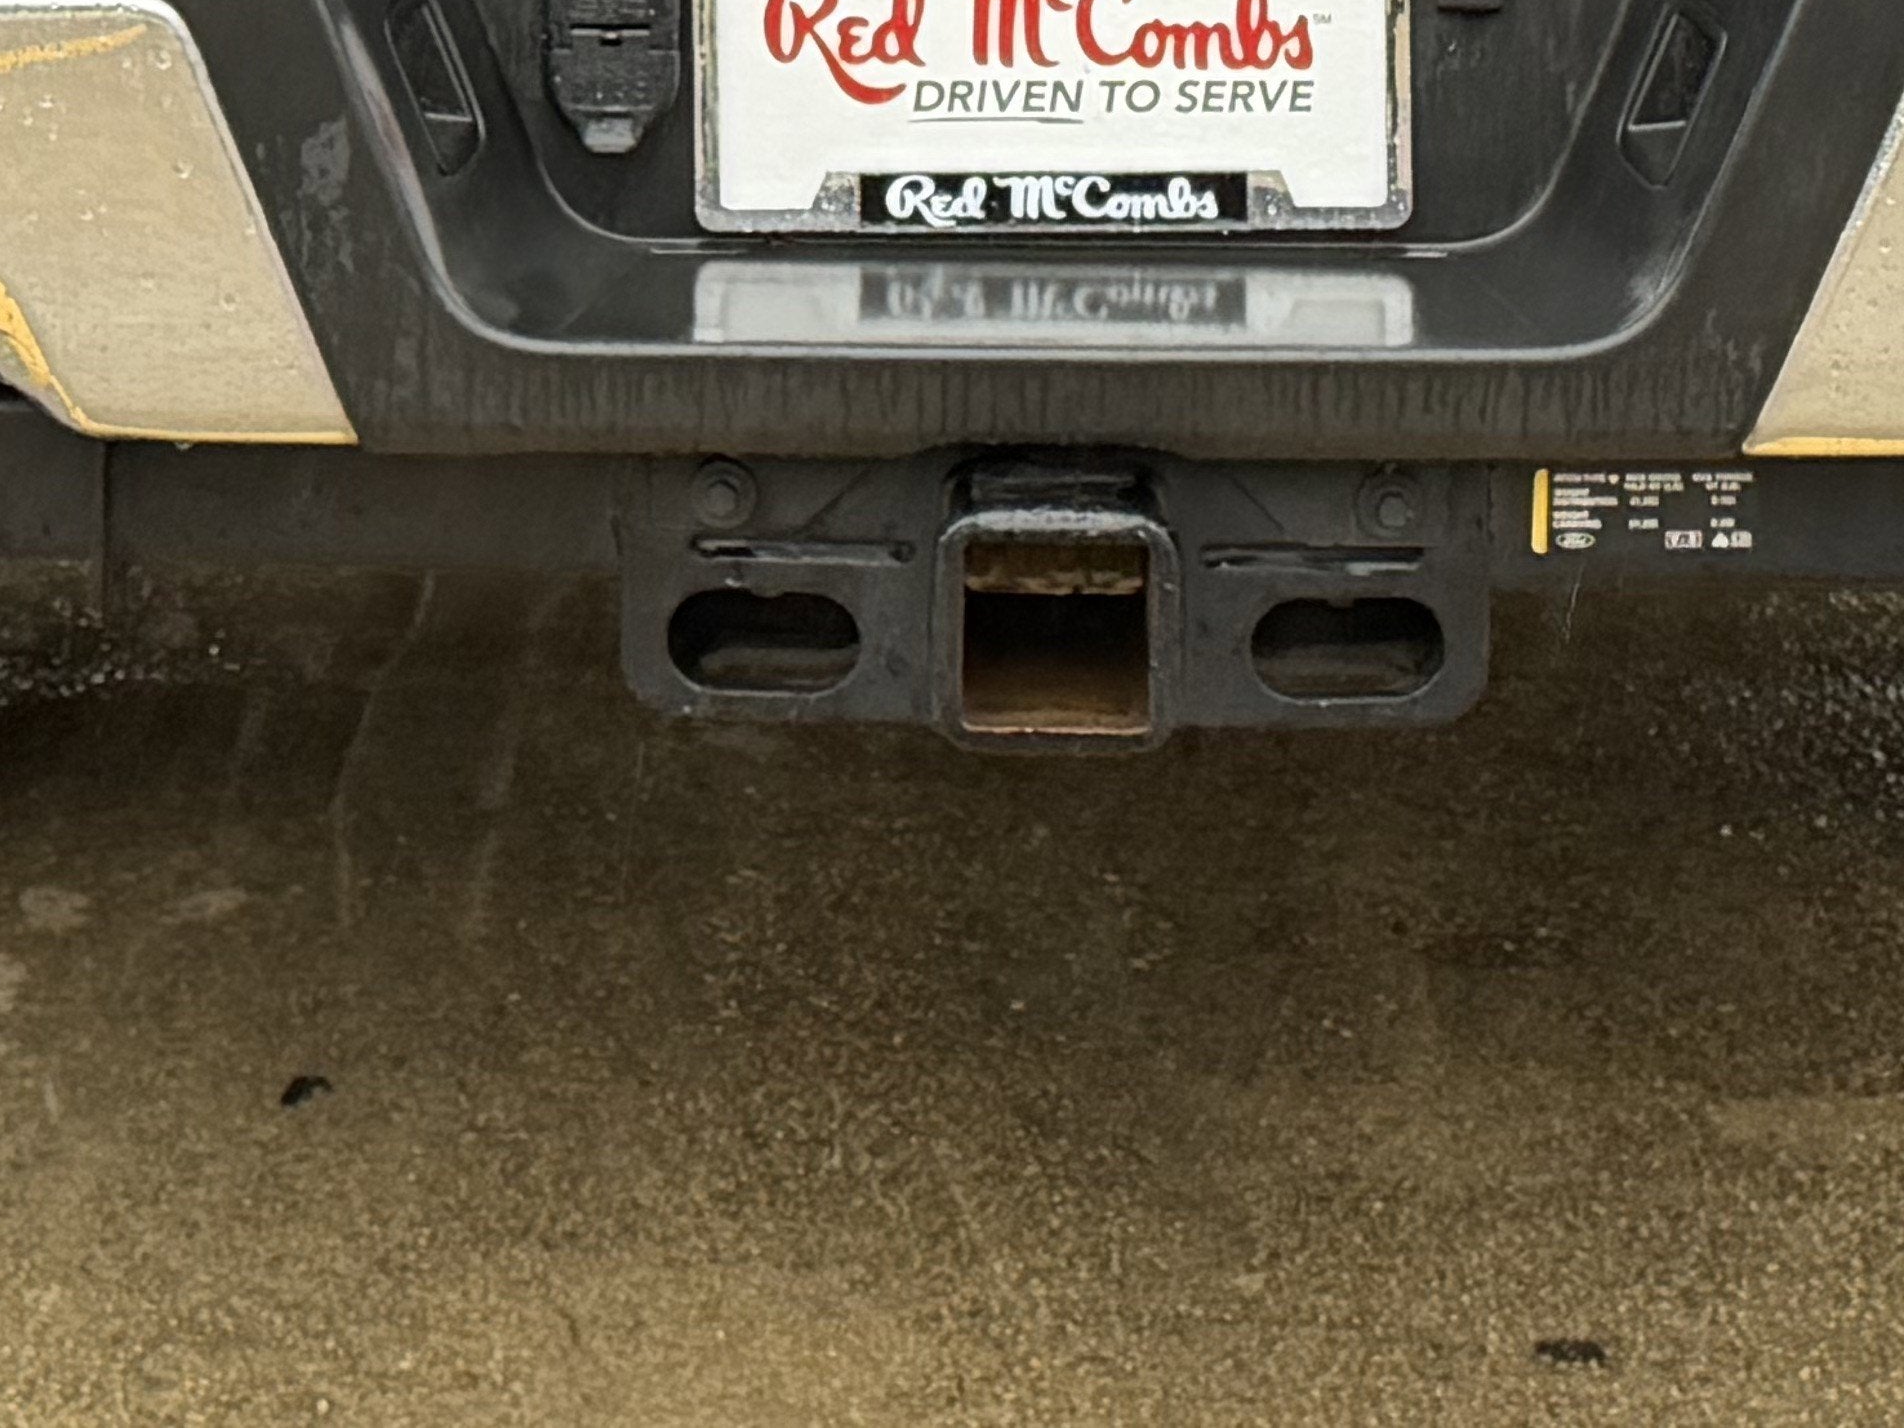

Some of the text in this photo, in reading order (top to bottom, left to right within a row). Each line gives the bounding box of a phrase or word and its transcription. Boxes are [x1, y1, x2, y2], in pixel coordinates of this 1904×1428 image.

[912, 79, 1316, 114] DRIVEN TO SERVE
[885, 174, 1219, 228] Red McCombs
